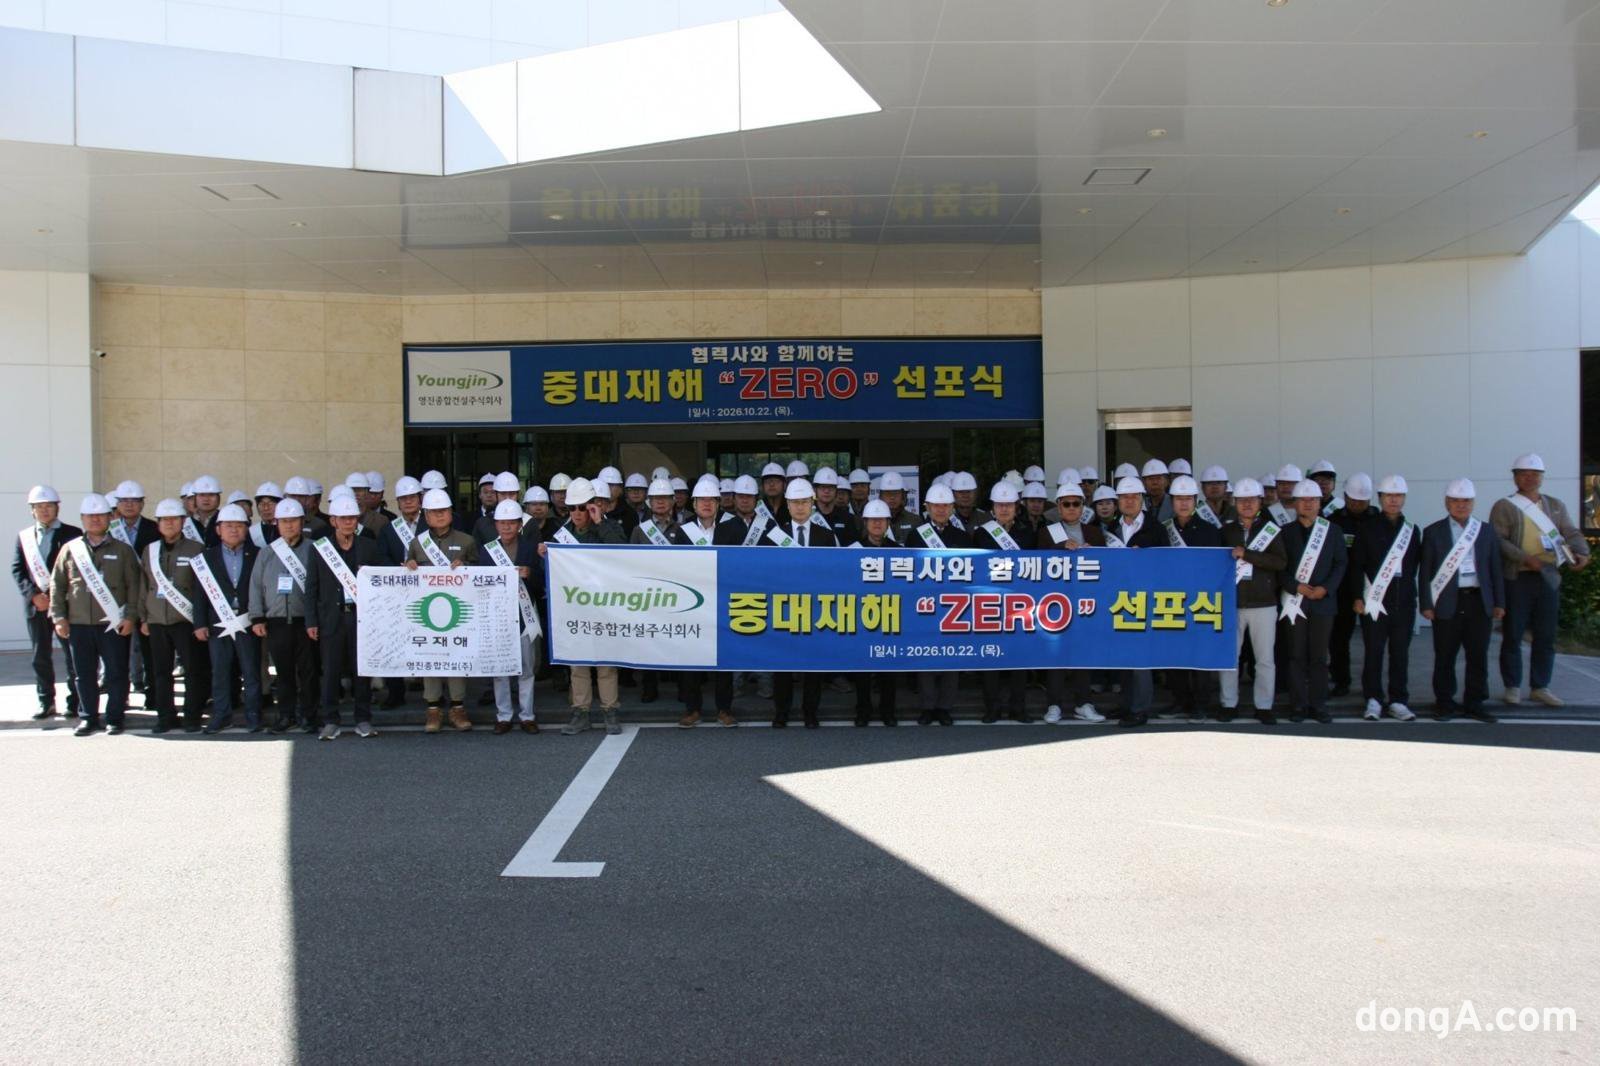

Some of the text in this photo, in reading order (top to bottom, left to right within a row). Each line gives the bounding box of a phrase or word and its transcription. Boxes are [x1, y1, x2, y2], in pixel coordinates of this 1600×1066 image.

[692, 344, 854, 364] 협력사와 함께하는
[416, 374, 488, 389] Youngjin
[542, 368, 703, 406] 중대재해
[893, 365, 1003, 398] 선포식
[418, 395, 504, 406] 영진종합건설주식회사
[860, 555, 1101, 581] 협력사와 함께하는
[370, 574, 419, 587] 중대재해
[472, 574, 507, 587] 선포식
[562, 585, 678, 612] Youngjin
[728, 592, 901, 633] 중대재해
[1109, 590, 1223, 631] 선포식
[566, 618, 702, 640] 영진종합건설주식회사
[906, 646, 977, 657] 2026.10.22.
[406, 661, 473, 671] 영진종합건설(주)
